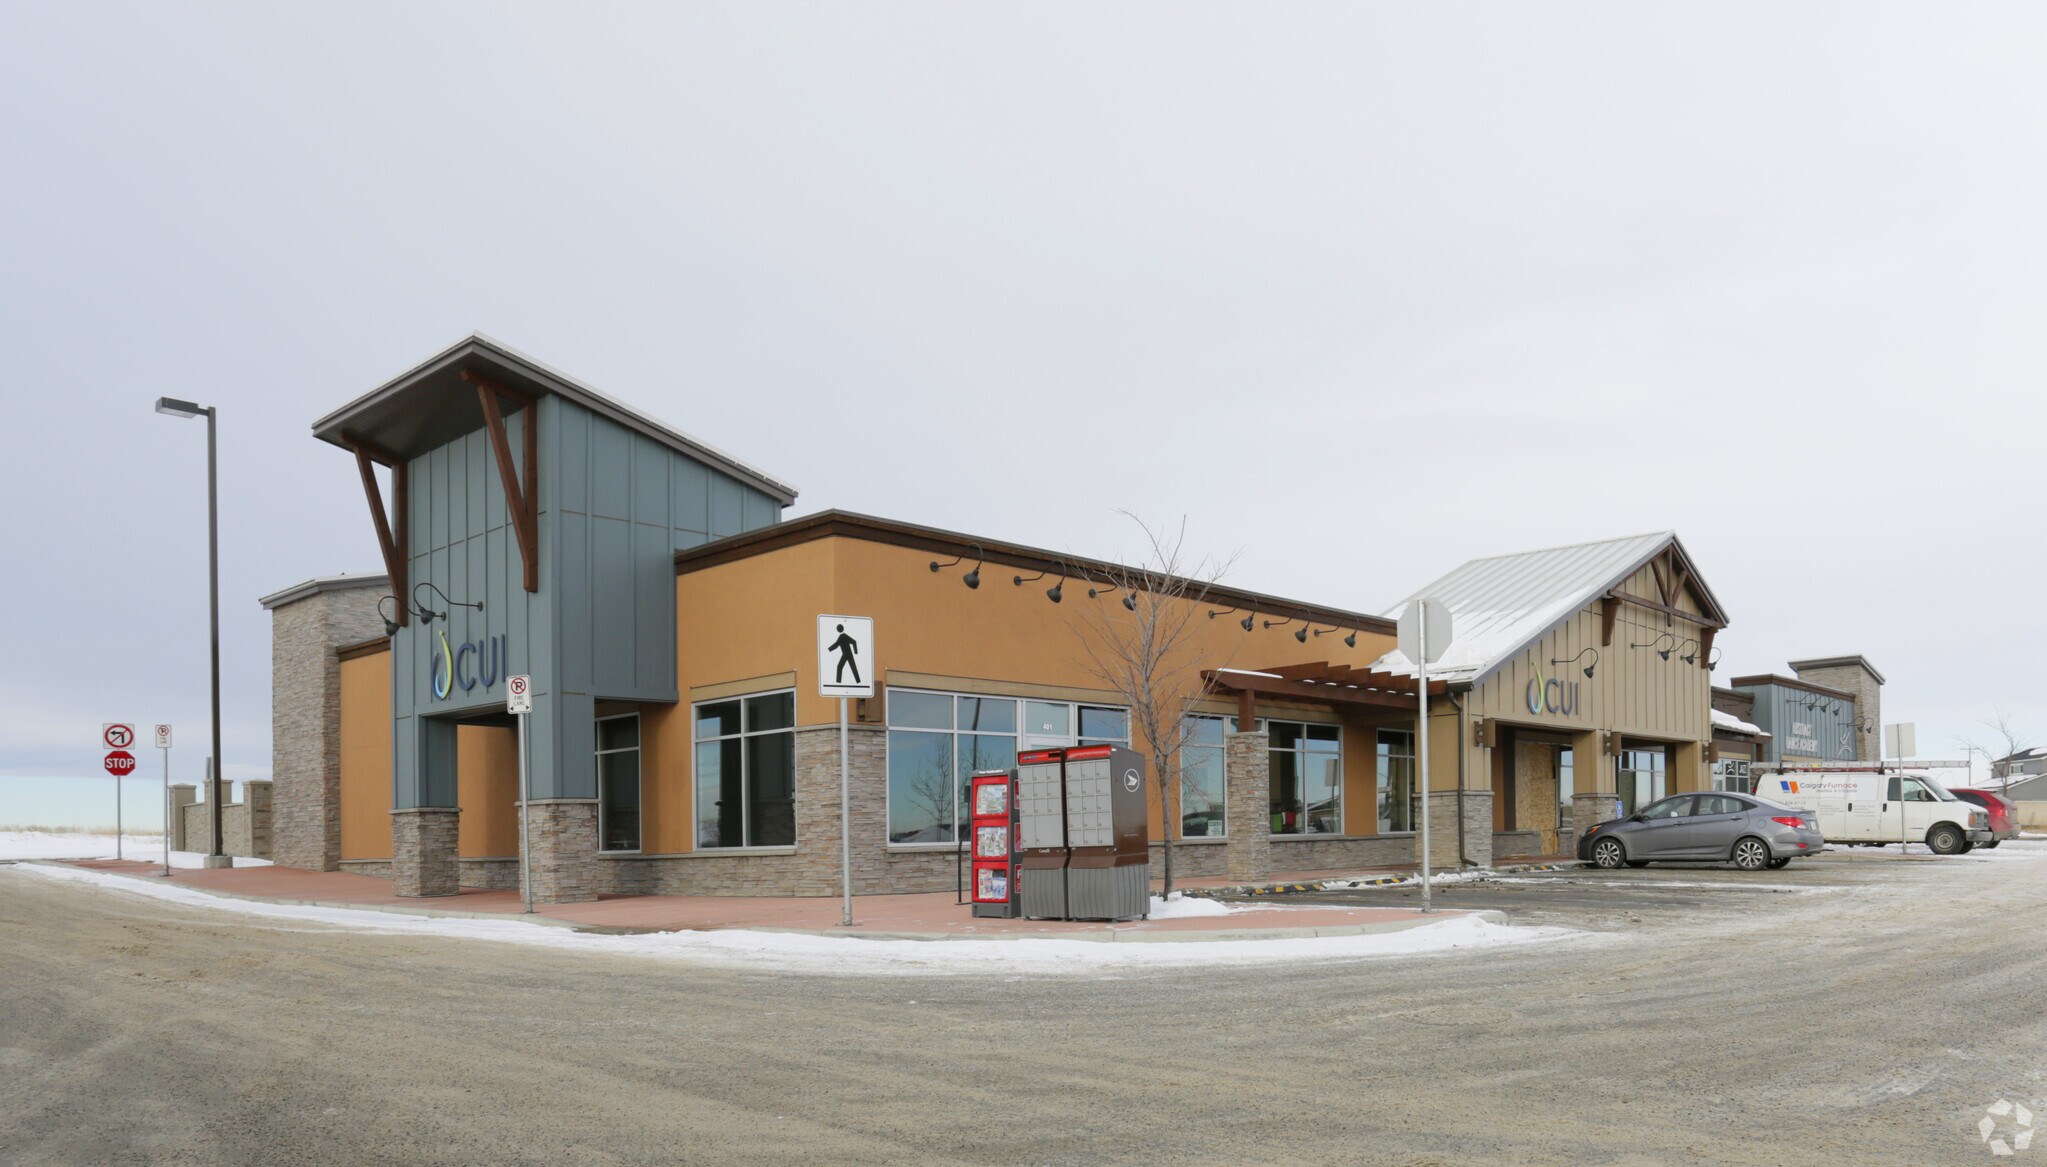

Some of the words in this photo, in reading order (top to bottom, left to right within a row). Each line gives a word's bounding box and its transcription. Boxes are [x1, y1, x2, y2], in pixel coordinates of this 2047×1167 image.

[105, 757, 135, 769] STOP
[1799, 782, 1827, 791] Calgary
[1828, 782, 1858, 790] Furnace
